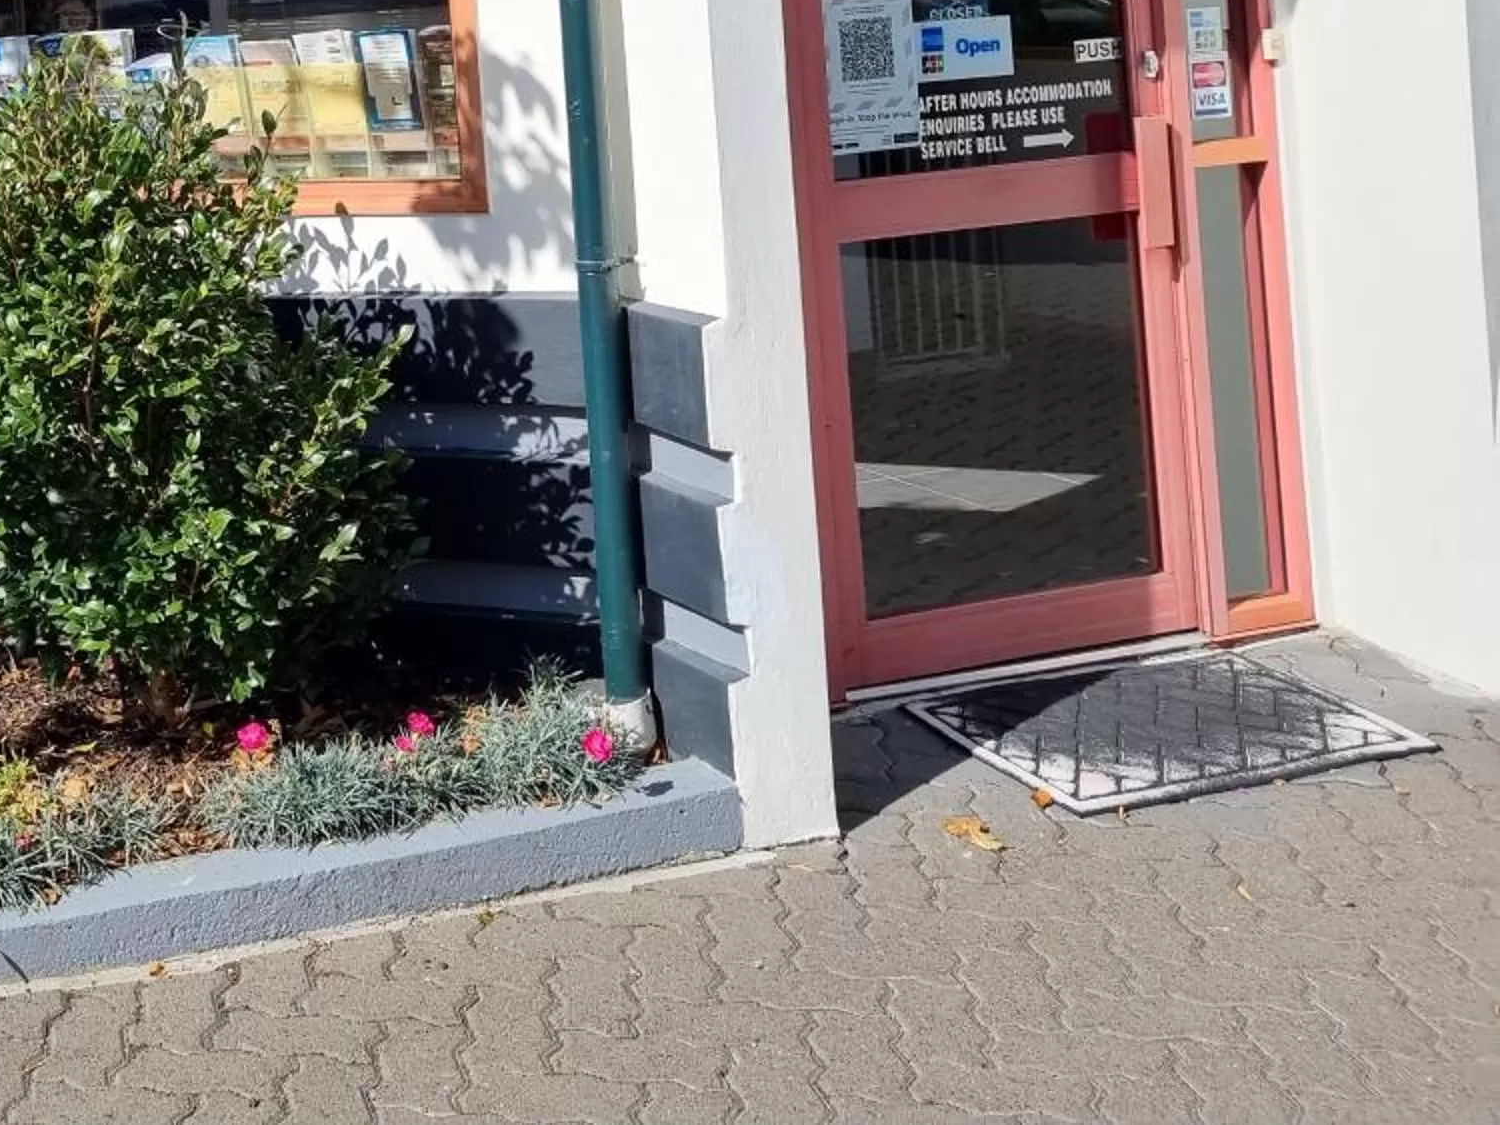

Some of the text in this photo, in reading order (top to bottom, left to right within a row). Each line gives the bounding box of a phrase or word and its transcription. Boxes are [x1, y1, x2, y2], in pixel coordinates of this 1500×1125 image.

[955, 38, 1001, 57] Open
[1075, 41, 1120, 60] PUSH
[919, 78, 1112, 114] AFTER HOURS ACCOMMODATION
[1199, 92, 1227, 106] VISA
[920, 114, 986, 137] ENQUIRIES
[991, 108, 1038, 130] PLEASE
[1041, 105, 1066, 126] USE
[921, 137, 973, 161] SERVICE
[976, 134, 1008, 155] BELL
